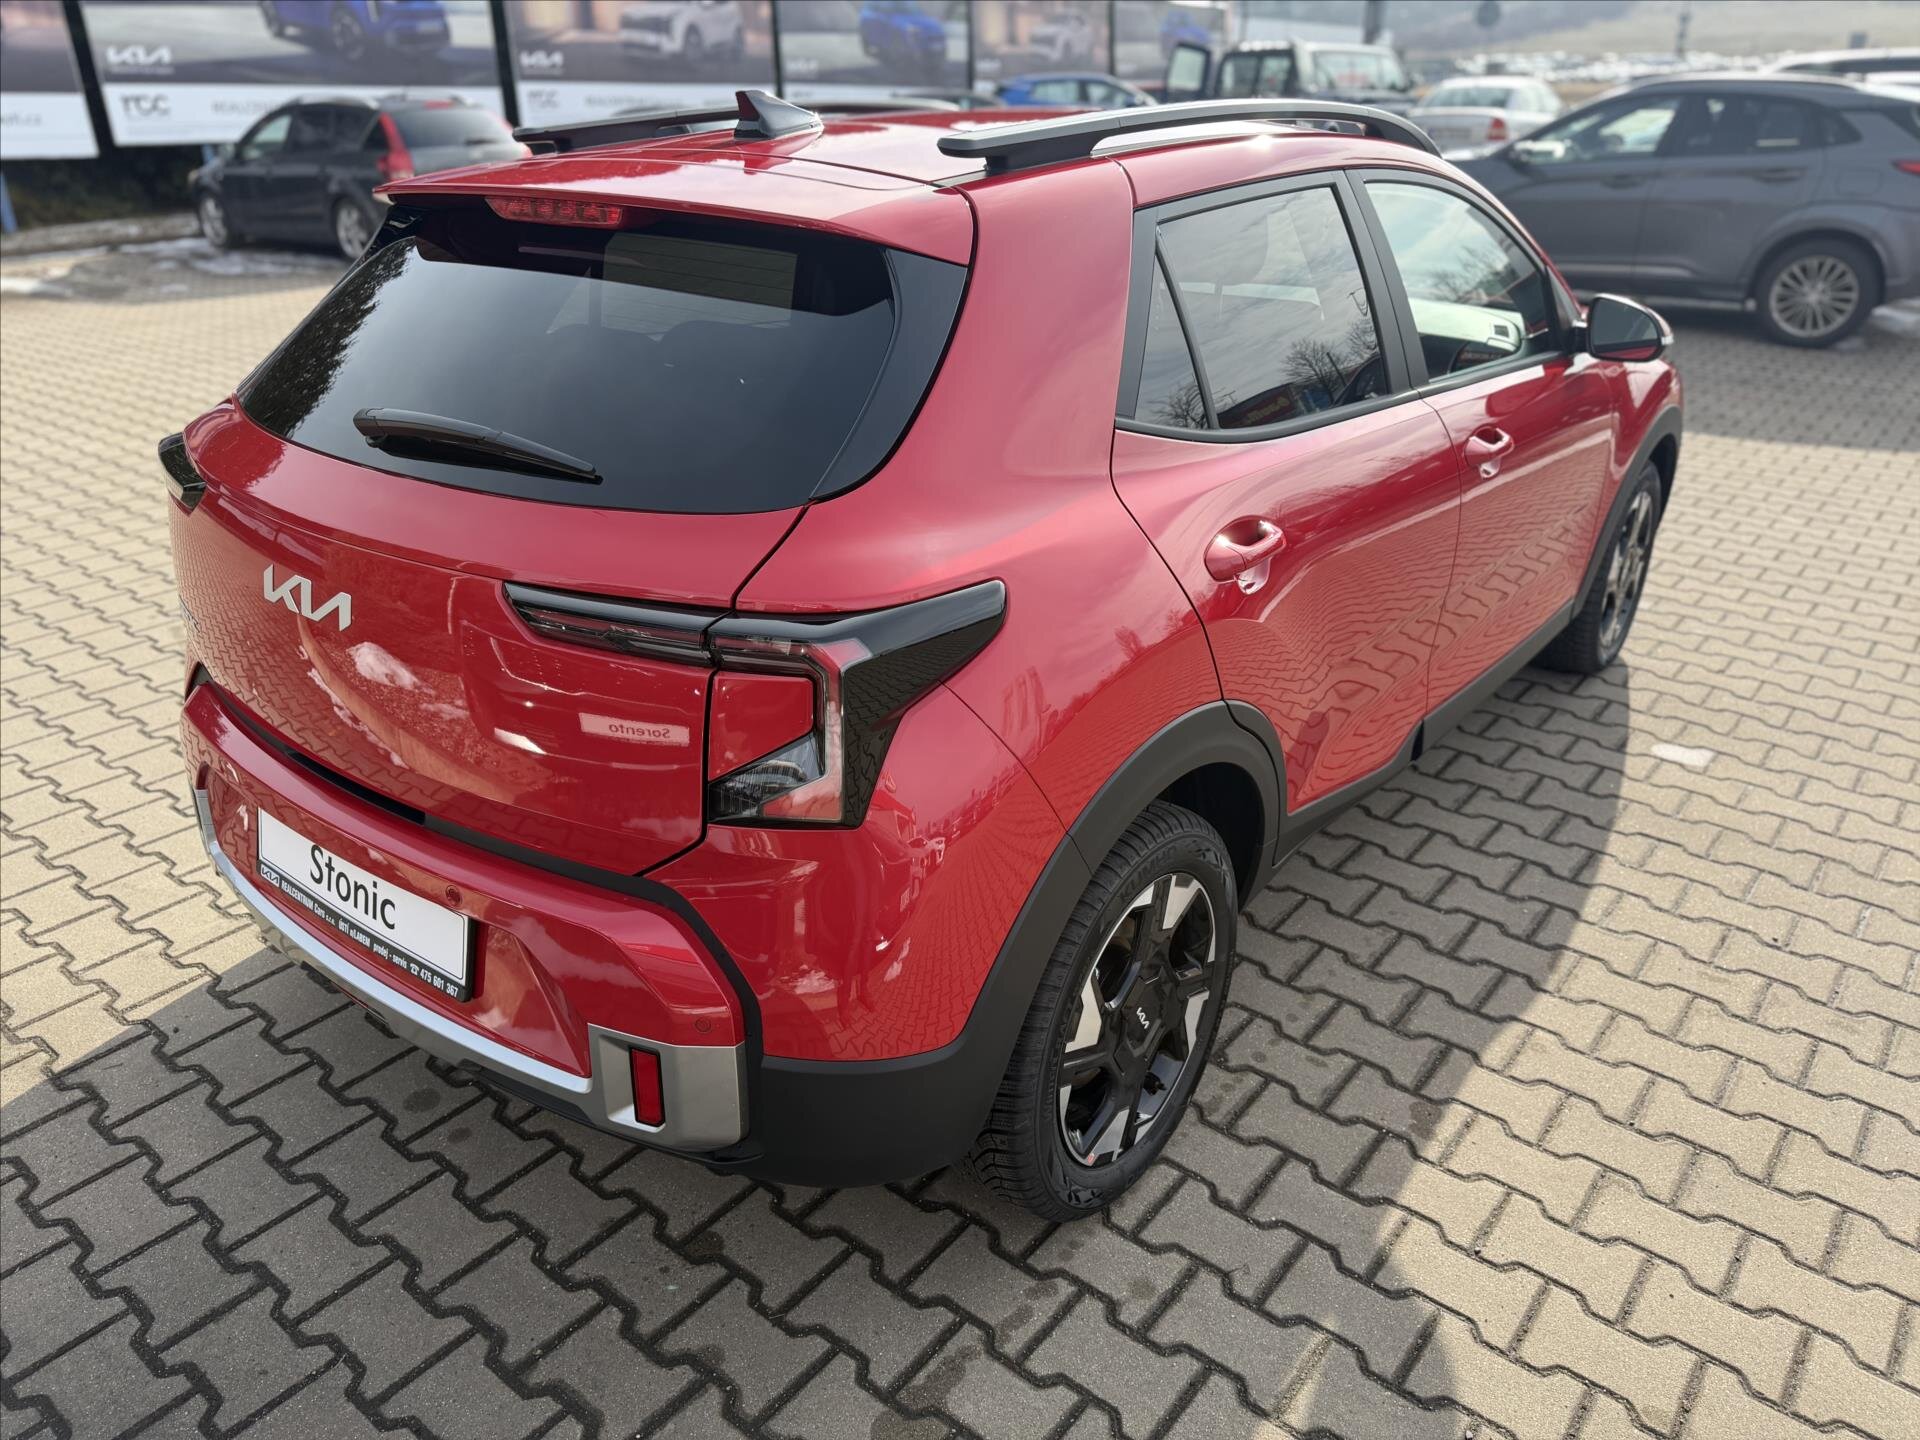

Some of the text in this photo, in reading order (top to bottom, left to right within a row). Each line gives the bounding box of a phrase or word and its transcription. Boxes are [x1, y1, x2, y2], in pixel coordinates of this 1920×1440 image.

[264, 564, 352, 632] KIA
[261, 867, 279, 885] KIA
[310, 844, 396, 930] Stonic
[420, 968, 432, 983] 475
[433, 976, 445, 991] 601
[446, 983, 459, 998] 367
[1136, 1007, 1150, 1030] KIA
